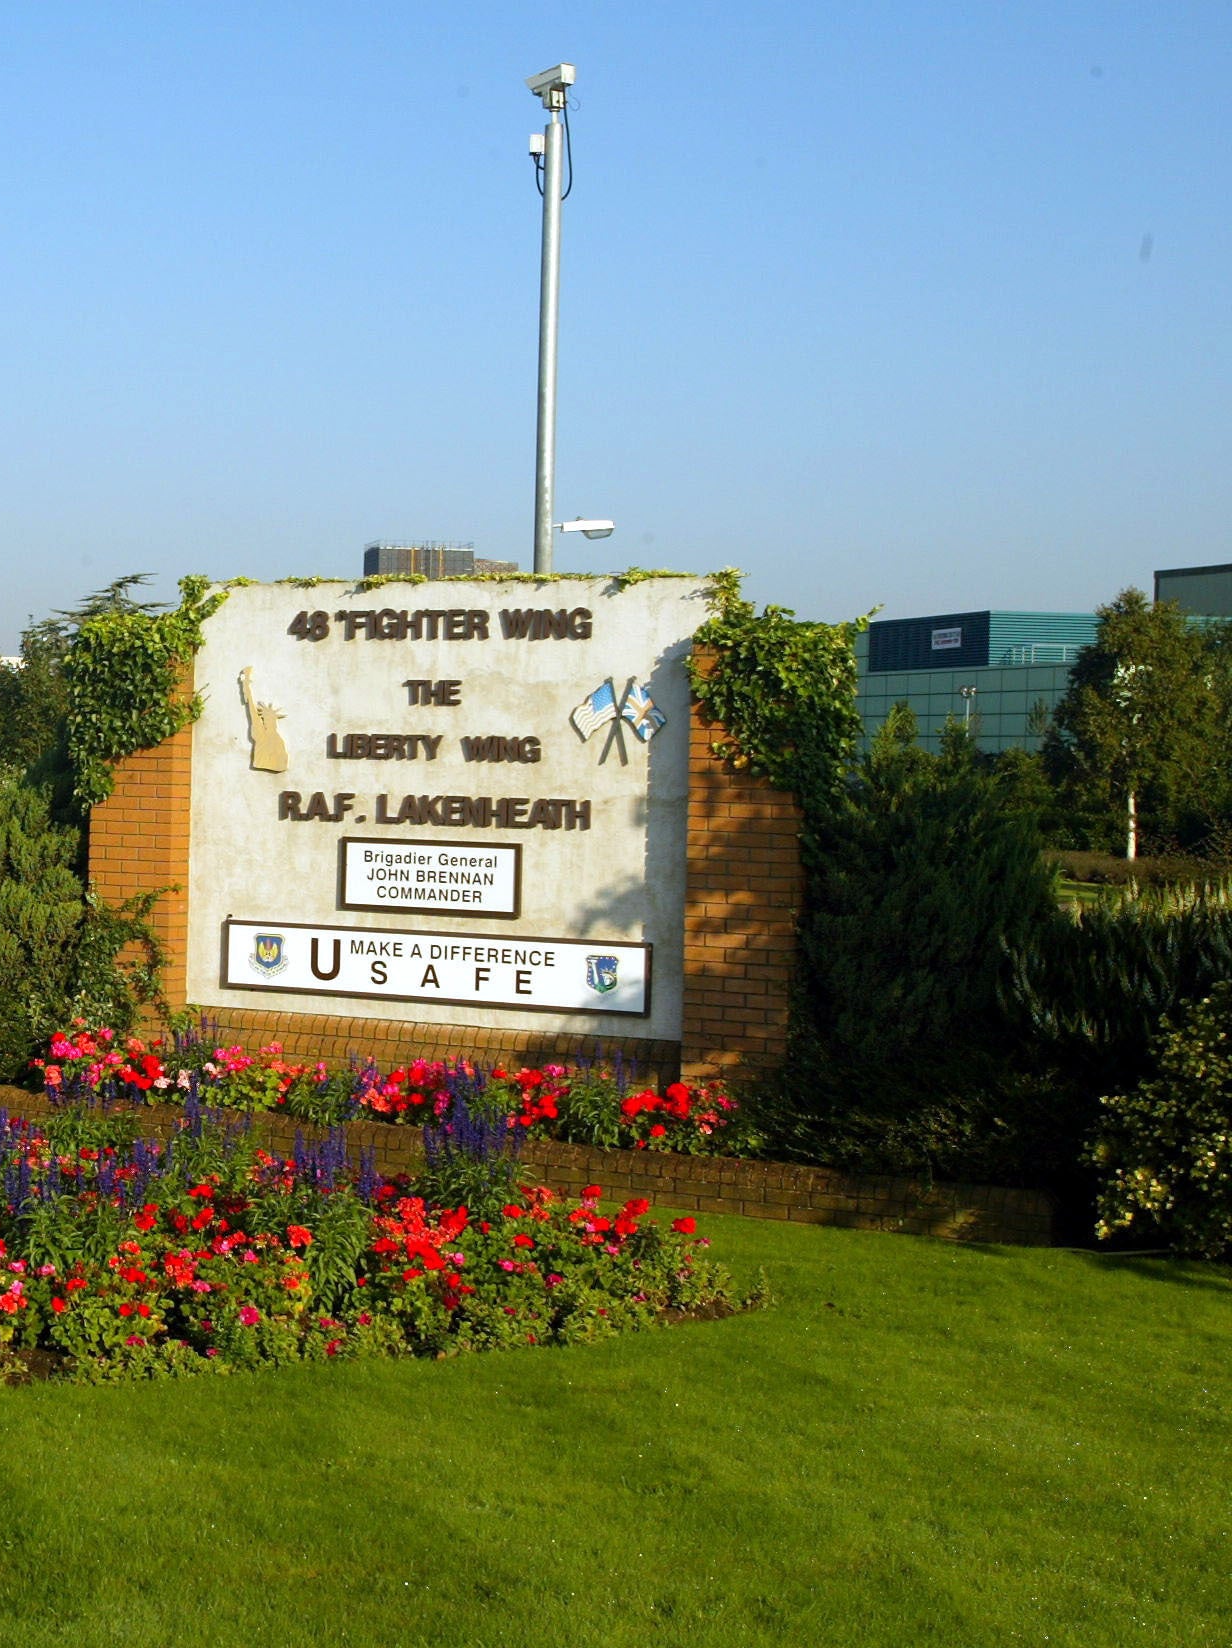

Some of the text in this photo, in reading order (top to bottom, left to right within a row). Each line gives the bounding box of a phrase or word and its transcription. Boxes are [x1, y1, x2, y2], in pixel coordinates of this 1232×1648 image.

[287, 607, 593, 642] 48 FIGHTER WING
[401, 679, 463, 706] THE
[326, 733, 541, 763] LIBERTY WING
[375, 793, 592, 831] LAKENHEATH
[364, 850, 498, 868] Brigadier General
[366, 868, 494, 886] JOHN BRENNAN
[376, 885, 482, 904] COMMANDER
[350, 939, 404, 958] MAKE
[410, 943, 423, 959] A
[430, 944, 556, 967] DIFFERENCE
